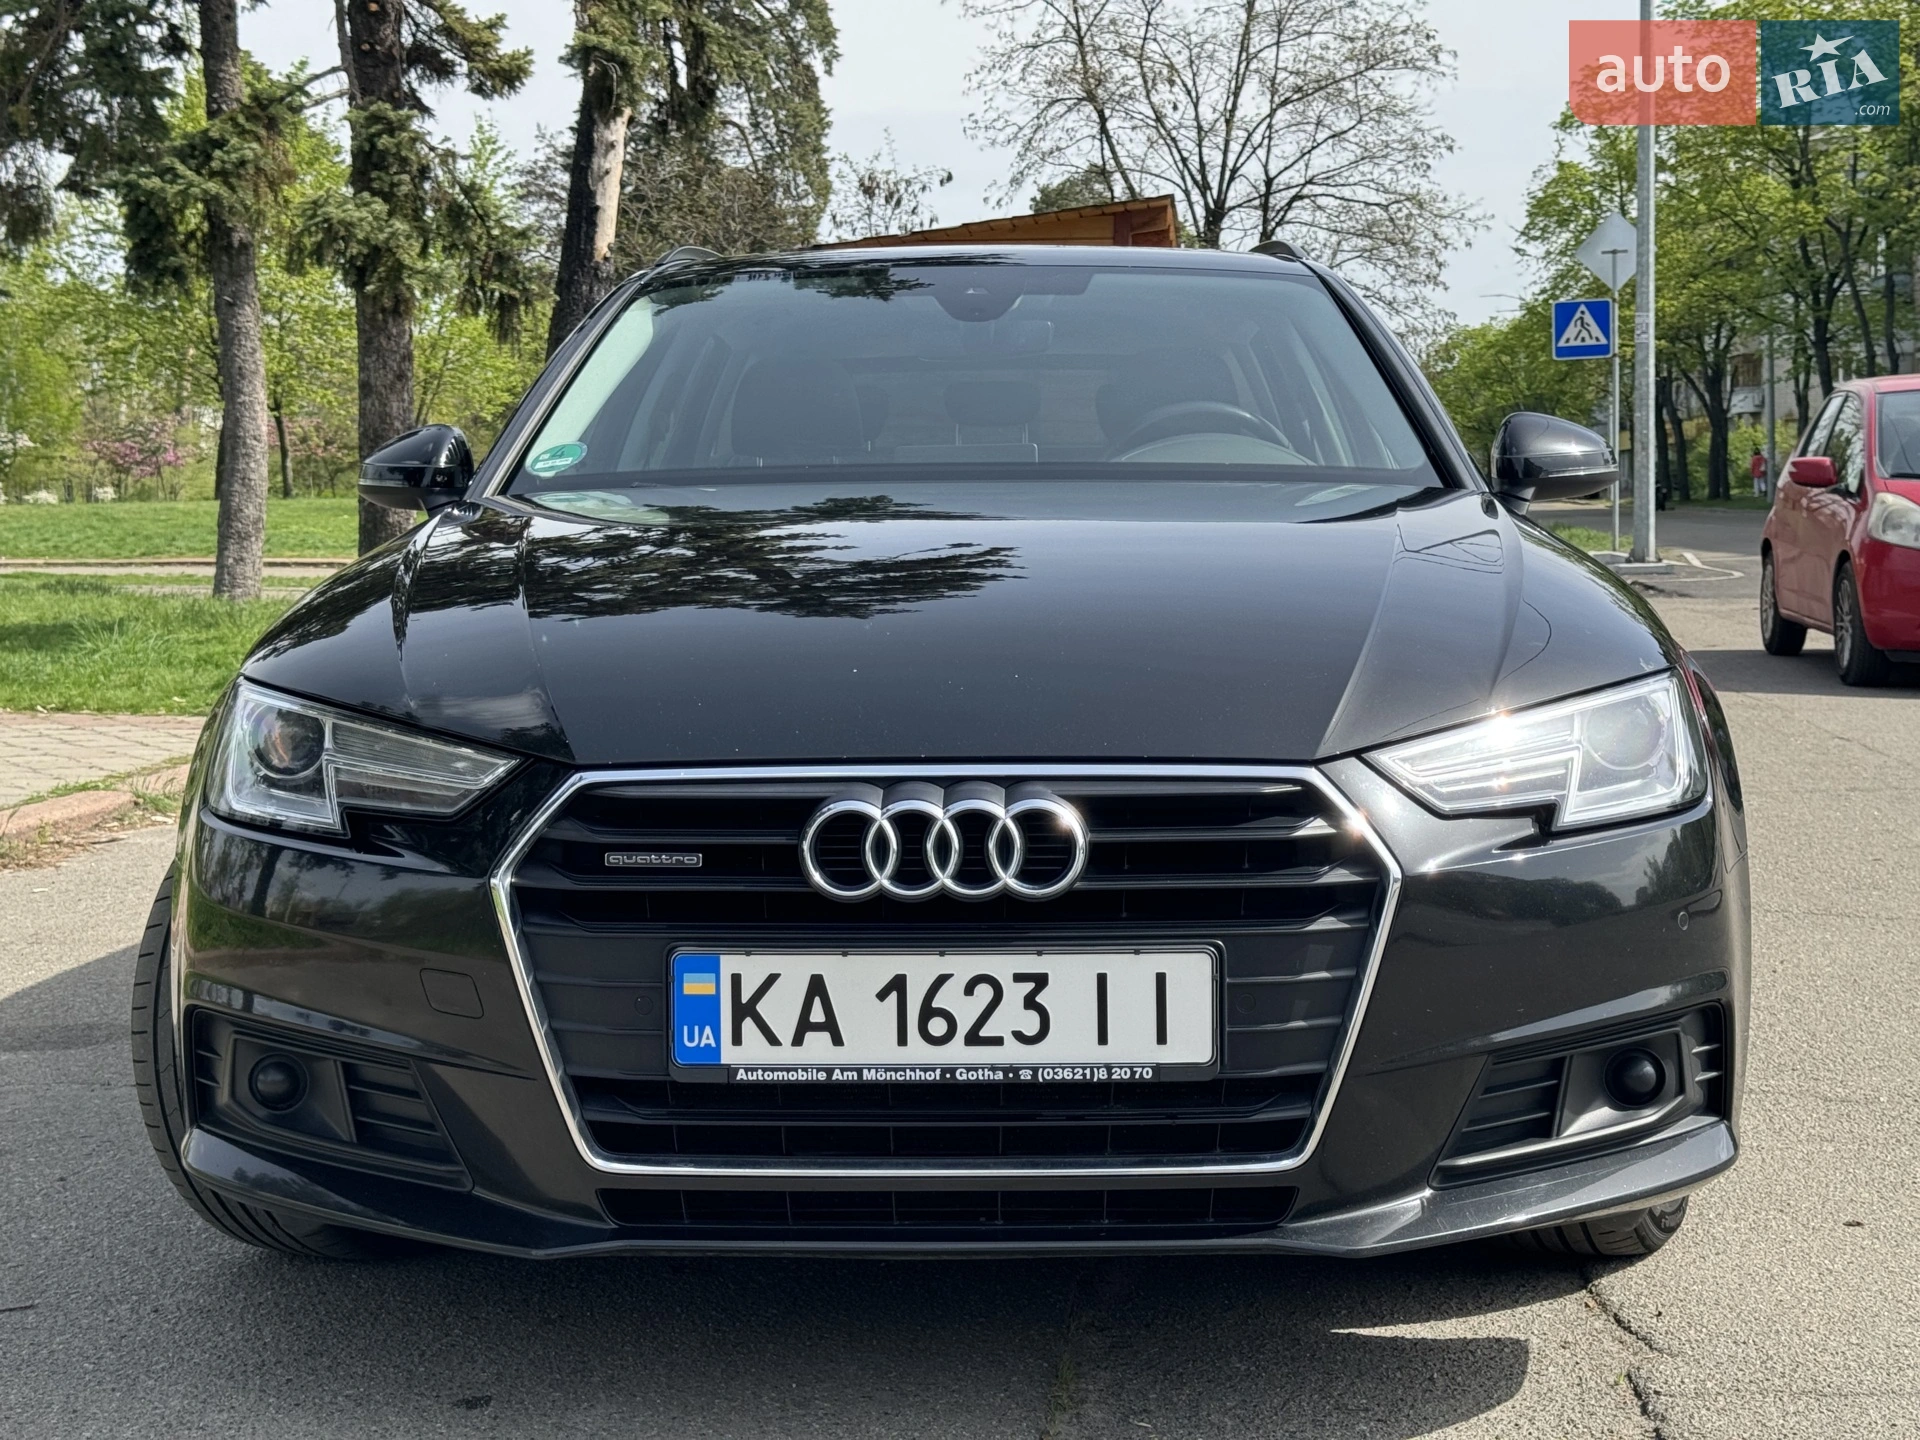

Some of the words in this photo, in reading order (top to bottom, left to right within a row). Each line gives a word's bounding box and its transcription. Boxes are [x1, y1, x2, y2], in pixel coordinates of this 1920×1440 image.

[552, 446, 566, 459] 4
[609, 854, 697, 865] quattro
[730, 972, 845, 1047] KA
[875, 972, 1051, 1047] 1623
[683, 1025, 717, 1048] UA
[735, 1068, 827, 1081] Automobile
[831, 1068, 858, 1081] Am
[862, 1068, 941, 1081] Mönchhof
[955, 1068, 1004, 1081] Gotha
